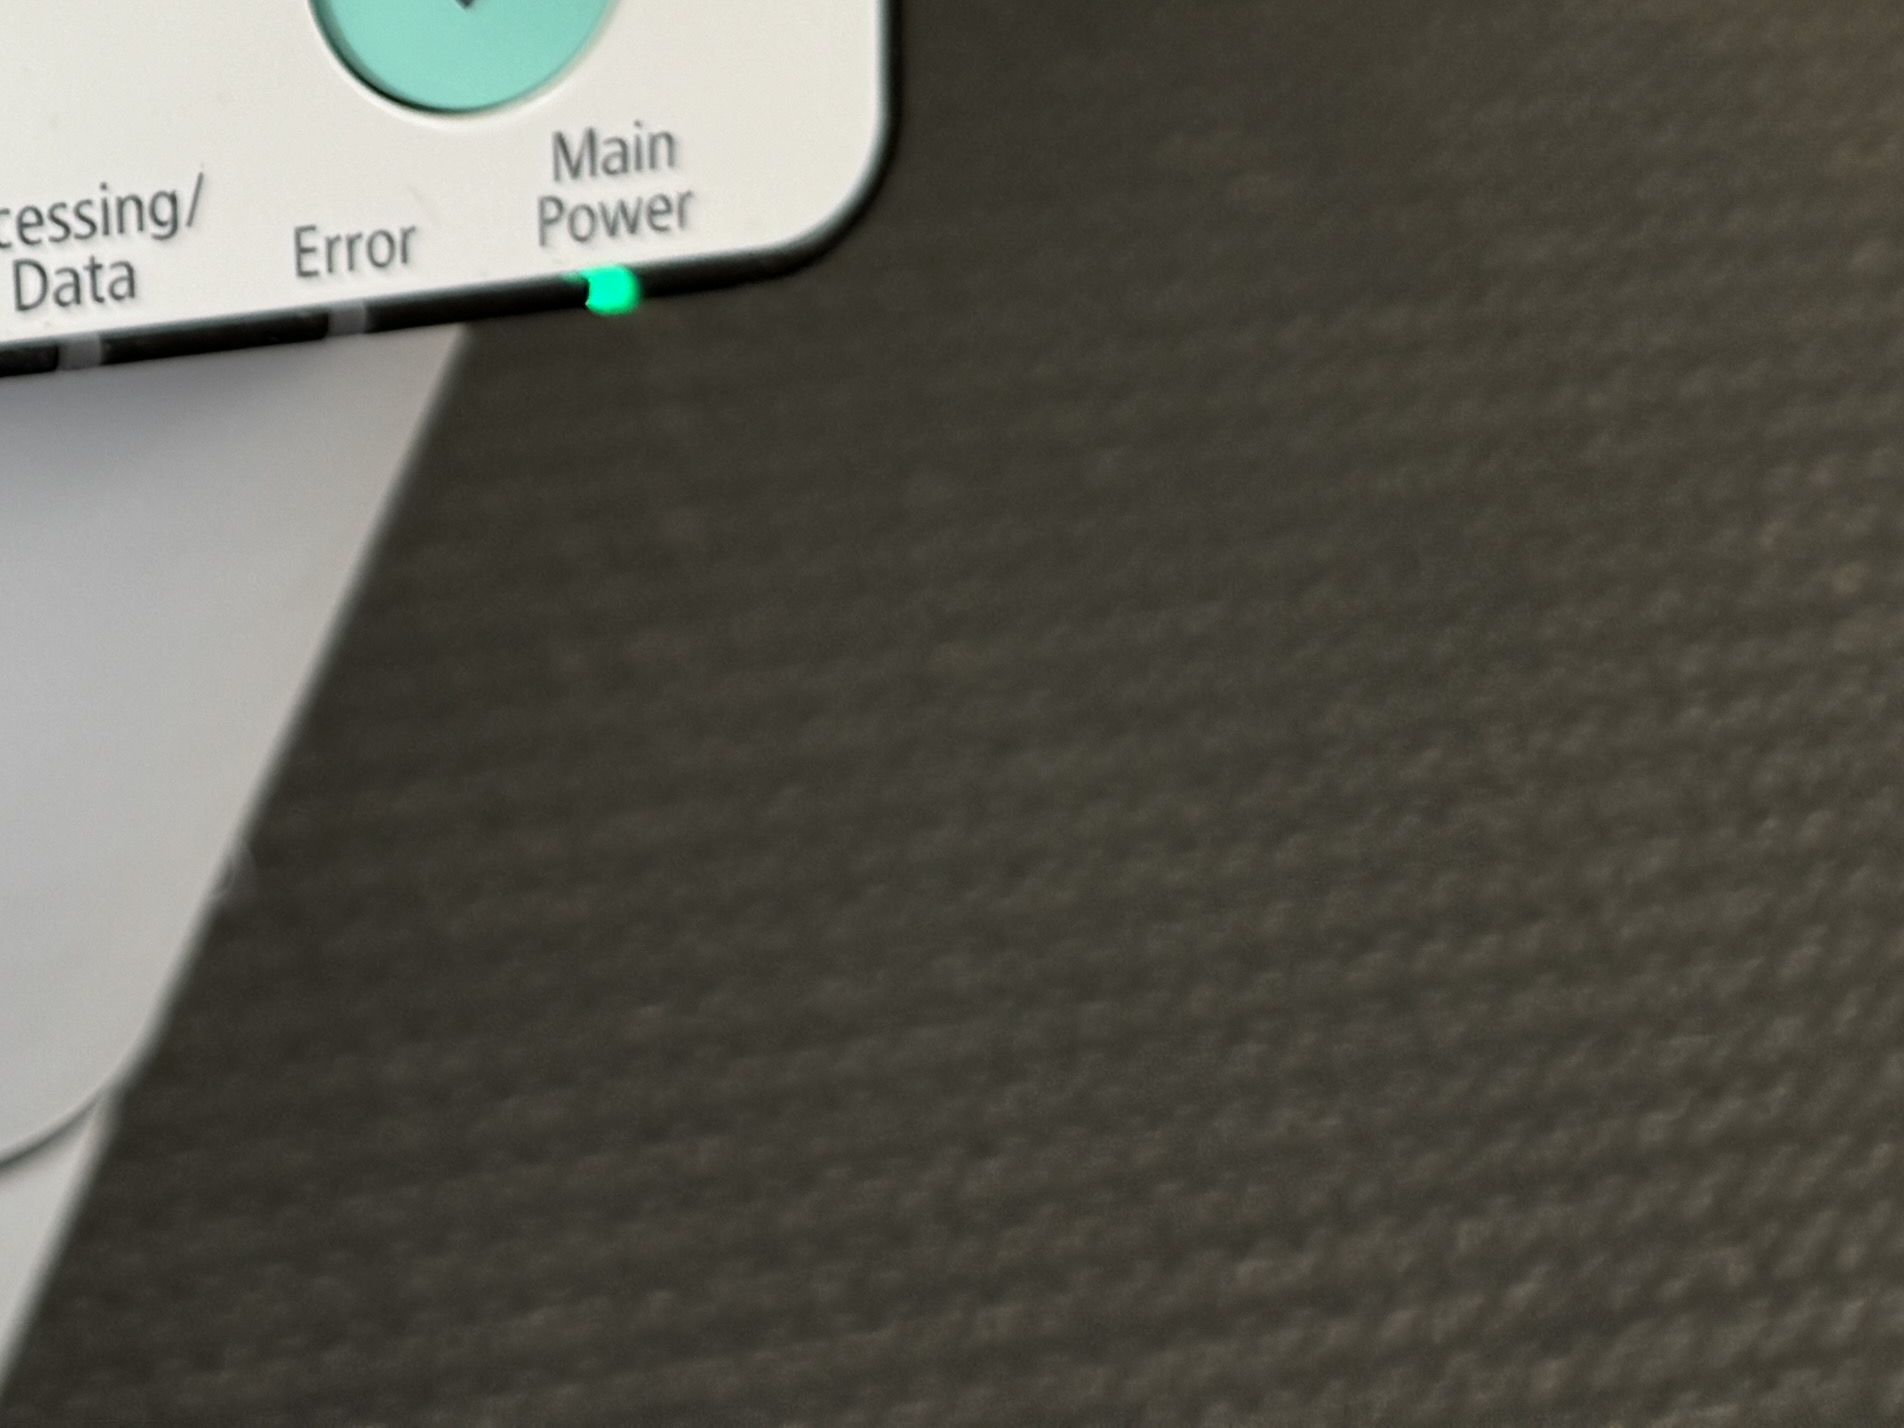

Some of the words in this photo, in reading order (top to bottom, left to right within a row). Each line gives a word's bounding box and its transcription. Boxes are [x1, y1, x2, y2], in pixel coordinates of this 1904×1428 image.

[550, 123, 678, 183] Main
[536, 185, 694, 247] Power
[293, 221, 416, 277] Error
[11, 256, 138, 310] Data
